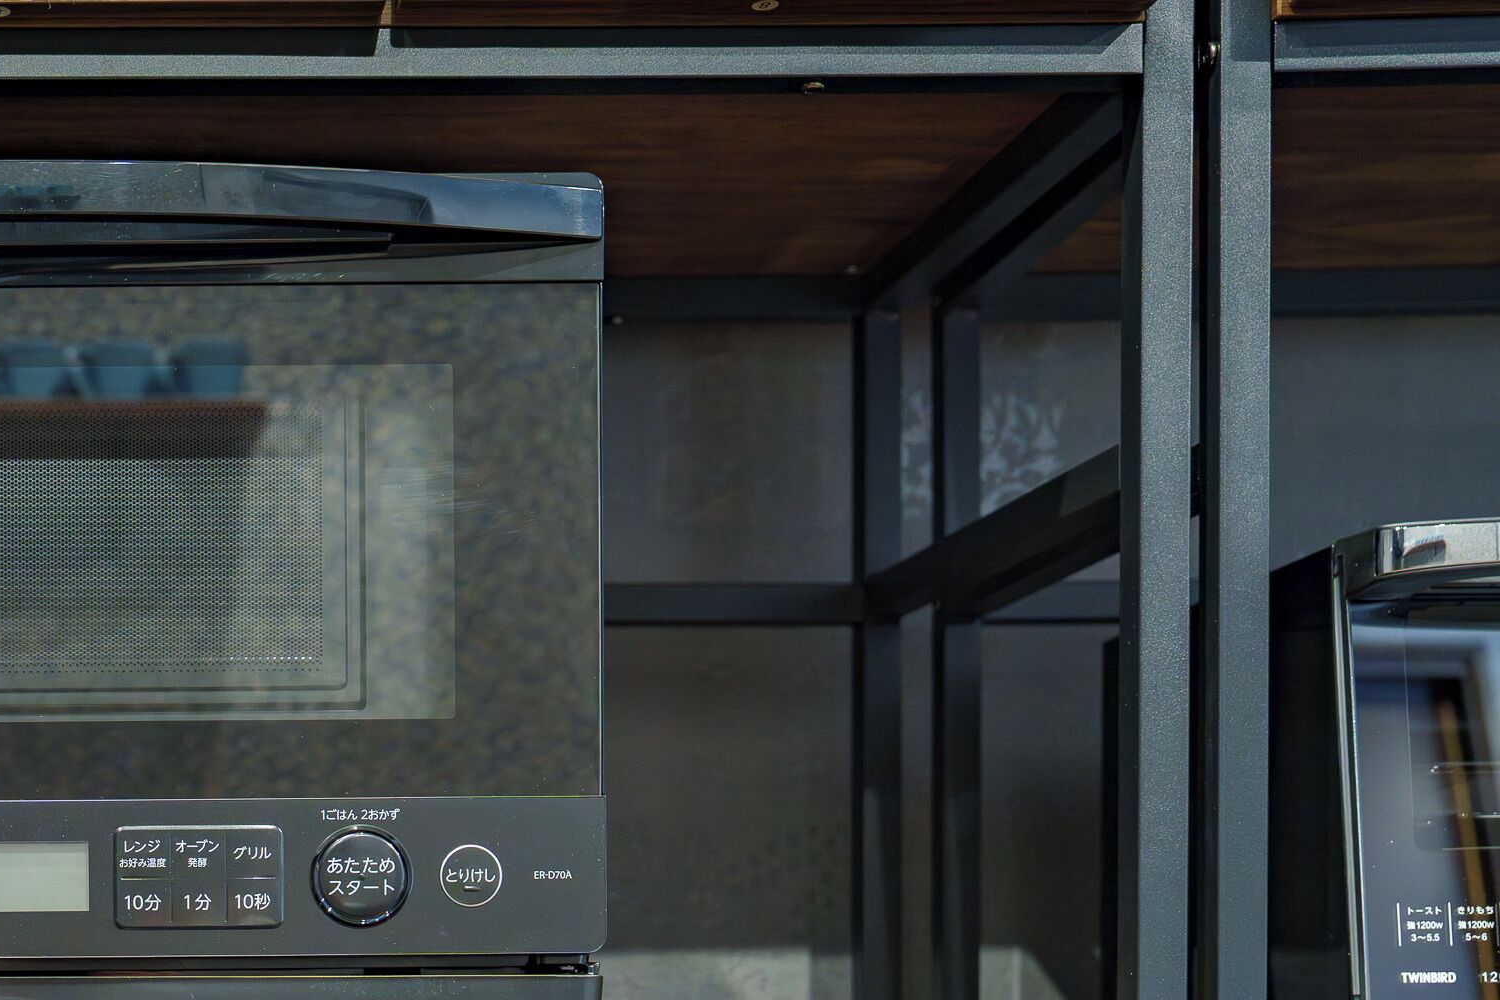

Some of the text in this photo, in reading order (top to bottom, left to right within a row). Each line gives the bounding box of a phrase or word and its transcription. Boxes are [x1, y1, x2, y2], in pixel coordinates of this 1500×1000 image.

[321, 808, 400, 820] 1ごはん 2おかず
[124, 839, 161, 853] レンジ
[175, 839, 220, 853] オーブン
[233, 846, 272, 860] グリル
[119, 857, 167, 868] お好み温度
[187, 857, 208, 868] 発酵
[326, 857, 396, 874] あたため
[445, 868, 496, 883] とりけし
[534, 870, 573, 880] ER-D70A
[328, 879, 395, 896] スタート
[124, 894, 162, 911] 10分
[183, 894, 212, 911] 1分
[234, 892, 271, 911] 10秒
[1407, 906, 1442, 915] トースト
[1457, 905, 1494, 915] きりもち
[1401, 971, 1500, 984] TWINBIRD 12
